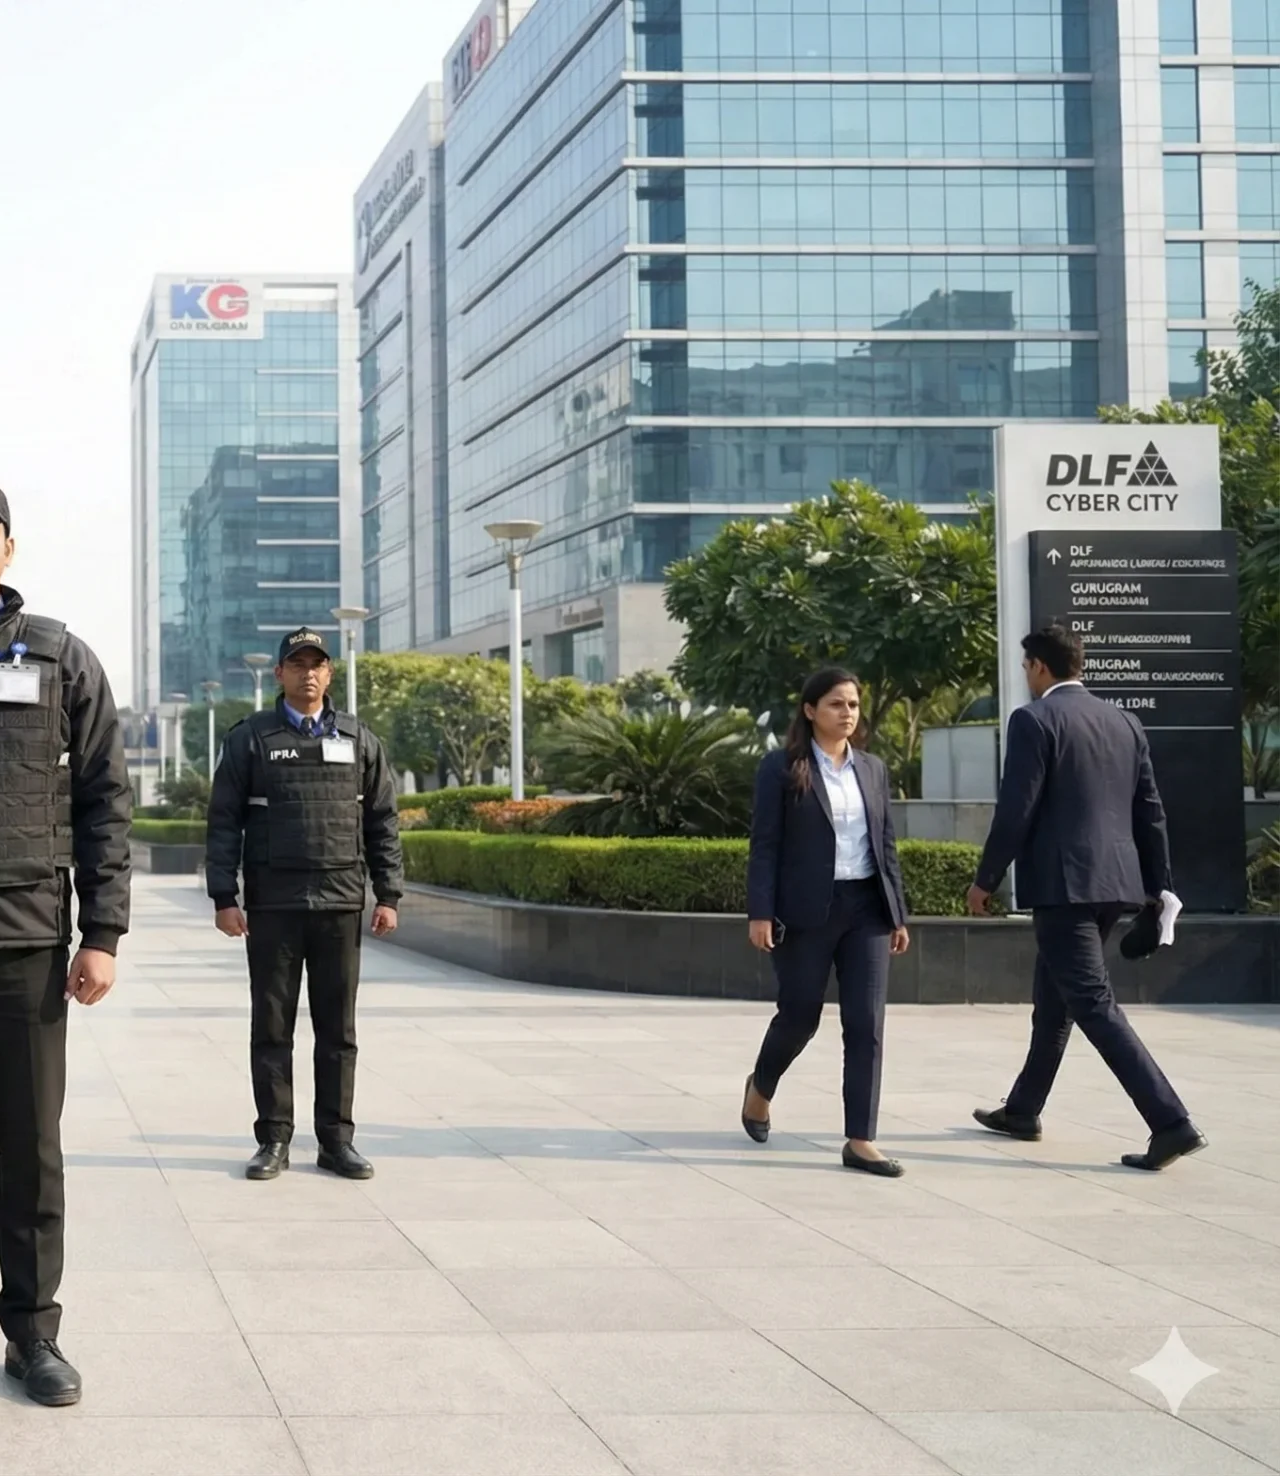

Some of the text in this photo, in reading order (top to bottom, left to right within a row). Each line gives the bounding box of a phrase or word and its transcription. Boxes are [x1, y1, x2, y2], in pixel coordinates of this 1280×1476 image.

[170, 283, 249, 320] KG
[1046, 454, 1131, 486] DLF
[1046, 493, 1178, 512] CYBER CITY
[1070, 545, 1093, 556] DLF
[1070, 583, 1141, 594] GURUGRAM
[1072, 621, 1094, 632] DLF
[1081, 659, 1141, 670] URUGRAM
[270, 749, 299, 760] IPRA
